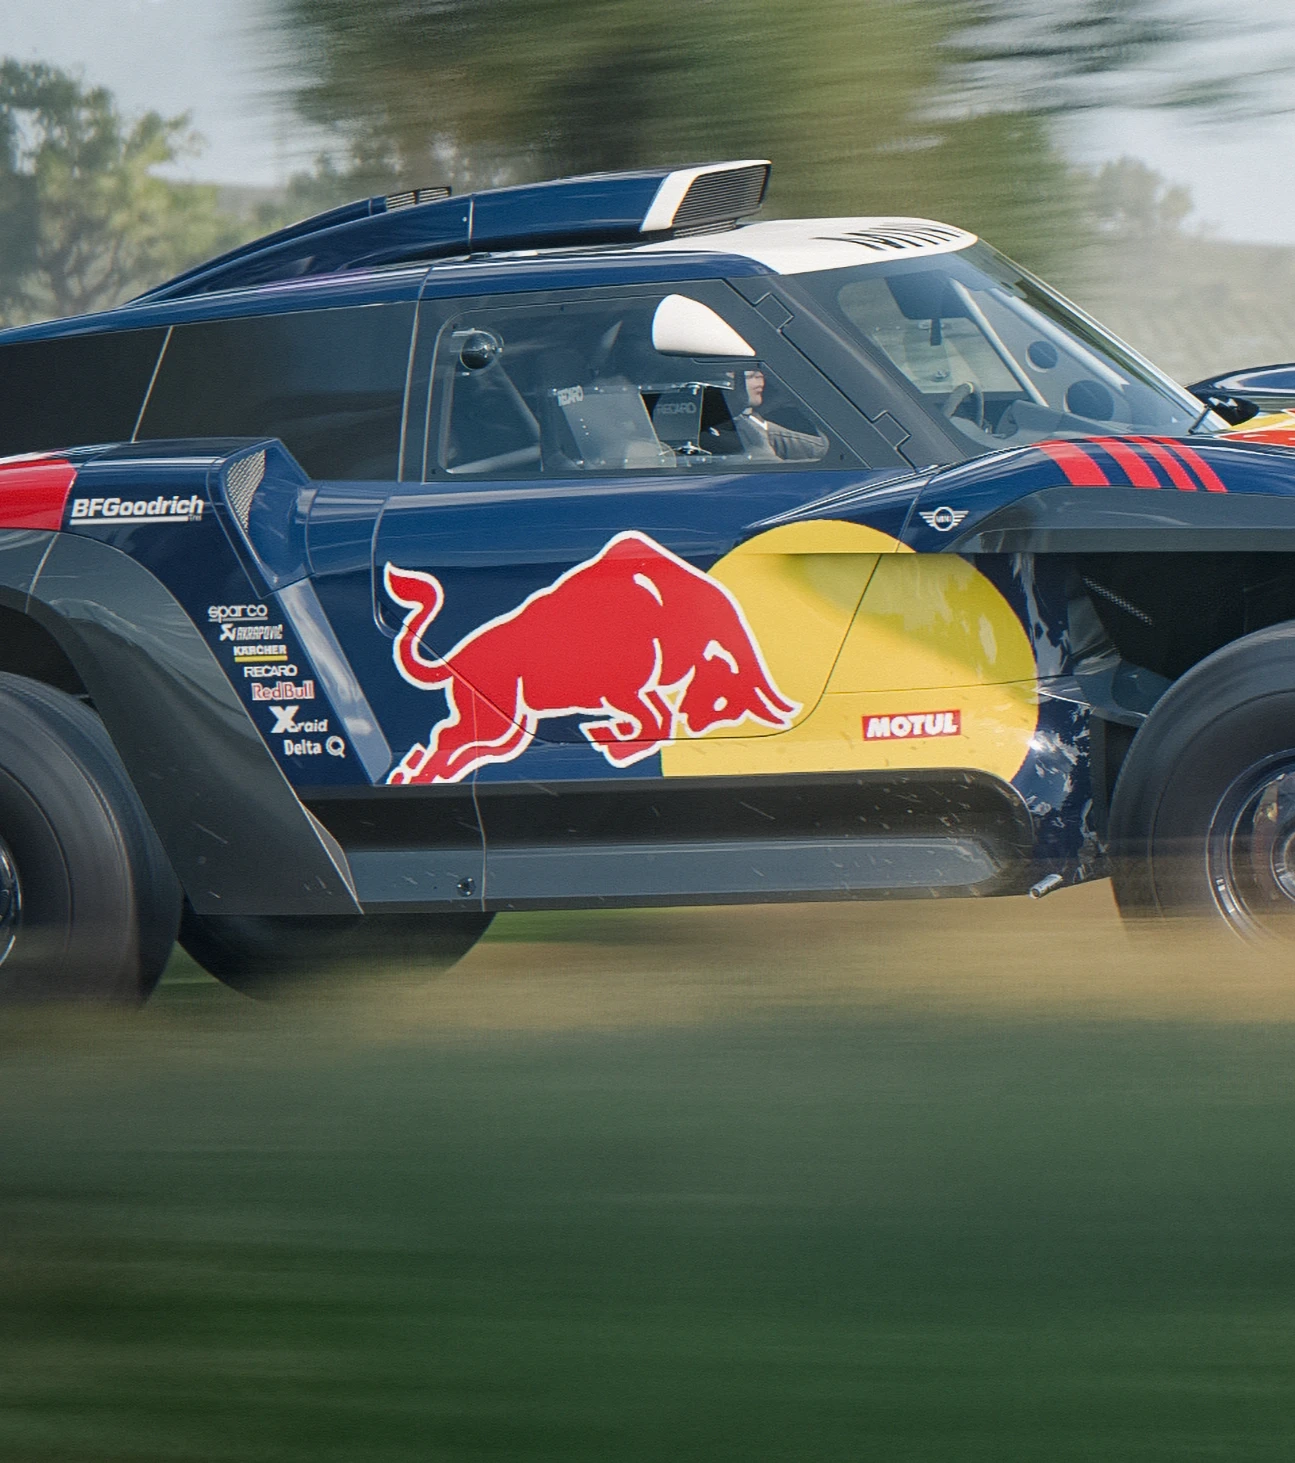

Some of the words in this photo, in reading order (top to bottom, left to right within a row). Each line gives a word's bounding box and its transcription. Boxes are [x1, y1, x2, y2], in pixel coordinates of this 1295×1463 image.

[71, 494, 205, 518] BFGoodrich
[208, 604, 268, 622] sparco
[244, 664, 298, 678] RECARO
[866, 712, 959, 738] MOTUL
[284, 739, 322, 755] Delta
[326, 735, 345, 758] Q
